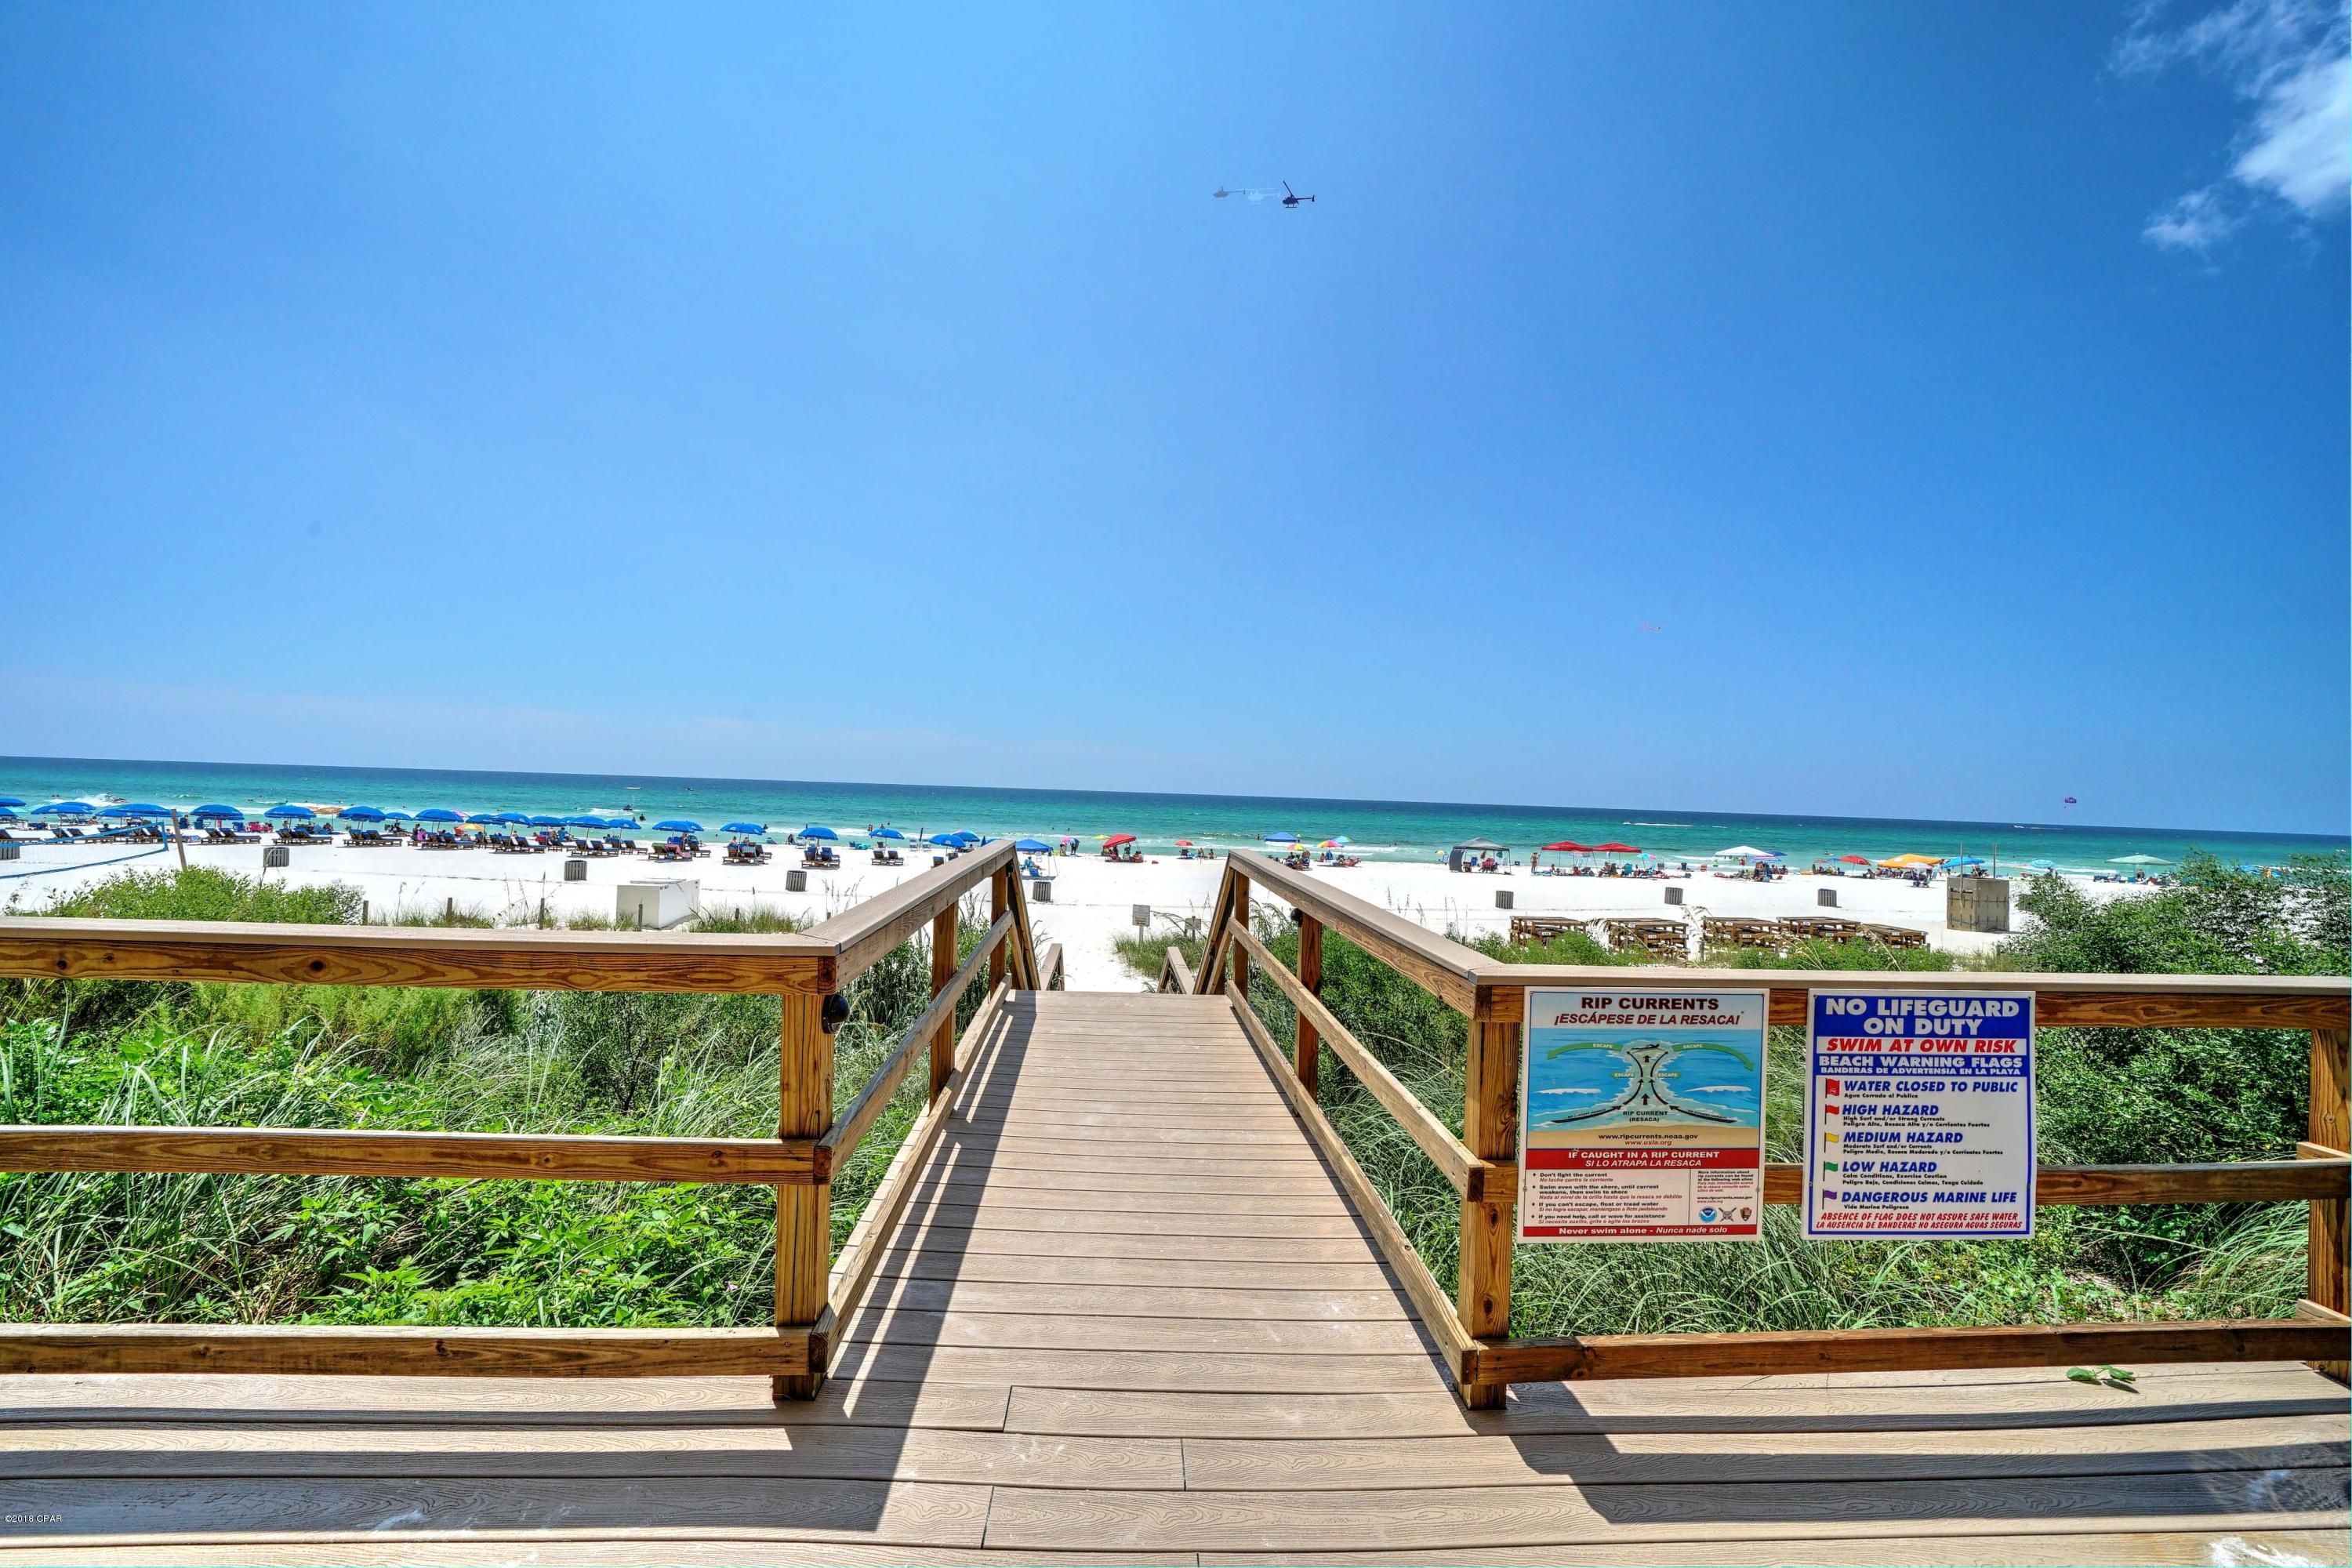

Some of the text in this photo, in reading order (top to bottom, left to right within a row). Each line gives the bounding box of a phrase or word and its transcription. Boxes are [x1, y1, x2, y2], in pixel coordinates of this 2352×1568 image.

[1581, 997, 1719, 1009] RIP CURRENTS
[1826, 999, 2019, 1016] NO LIFEGUARD
[1555, 1012, 1740, 1025] ¡ESCÁPESE DE LA RESACA!
[1864, 1018, 1982, 1034] ON DUTY
[1827, 1039, 2016, 1052] SWIM AT OWN RISK
[1819, 1056, 2022, 1067] BEACH WARNING FLAGS
[1845, 1081, 2017, 1091] WATER CLOSED TO PUBLIC
[1842, 1105, 1938, 1115] HIGH HAZARD
[1843, 1132, 1962, 1142] MEDIUM HAZARD
[1842, 1162, 1936, 1172] LOW HAZARD
[1842, 1192, 2016, 1202] DANGEROUS MARINE LIFE
